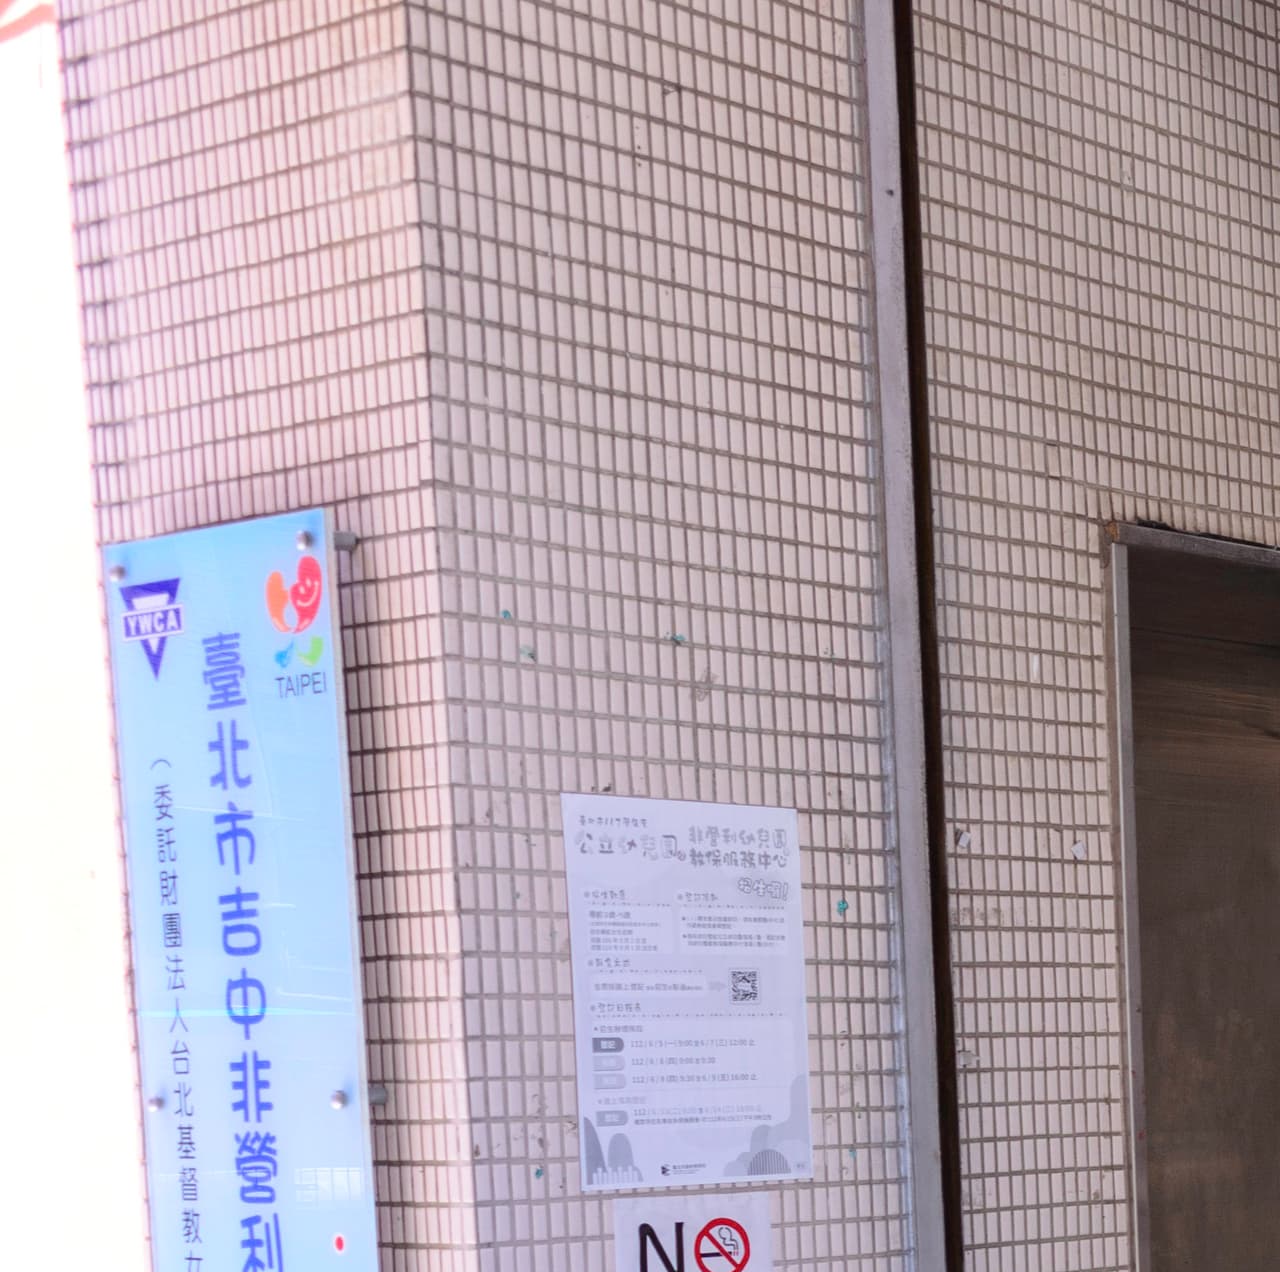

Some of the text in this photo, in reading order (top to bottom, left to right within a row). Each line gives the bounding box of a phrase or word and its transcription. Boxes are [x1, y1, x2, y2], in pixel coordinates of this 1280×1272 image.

[126, 609, 180, 636] YWCA
[274, 671, 328, 699] TAIPEI
[689, 850, 788, 869] 教保服務中心
